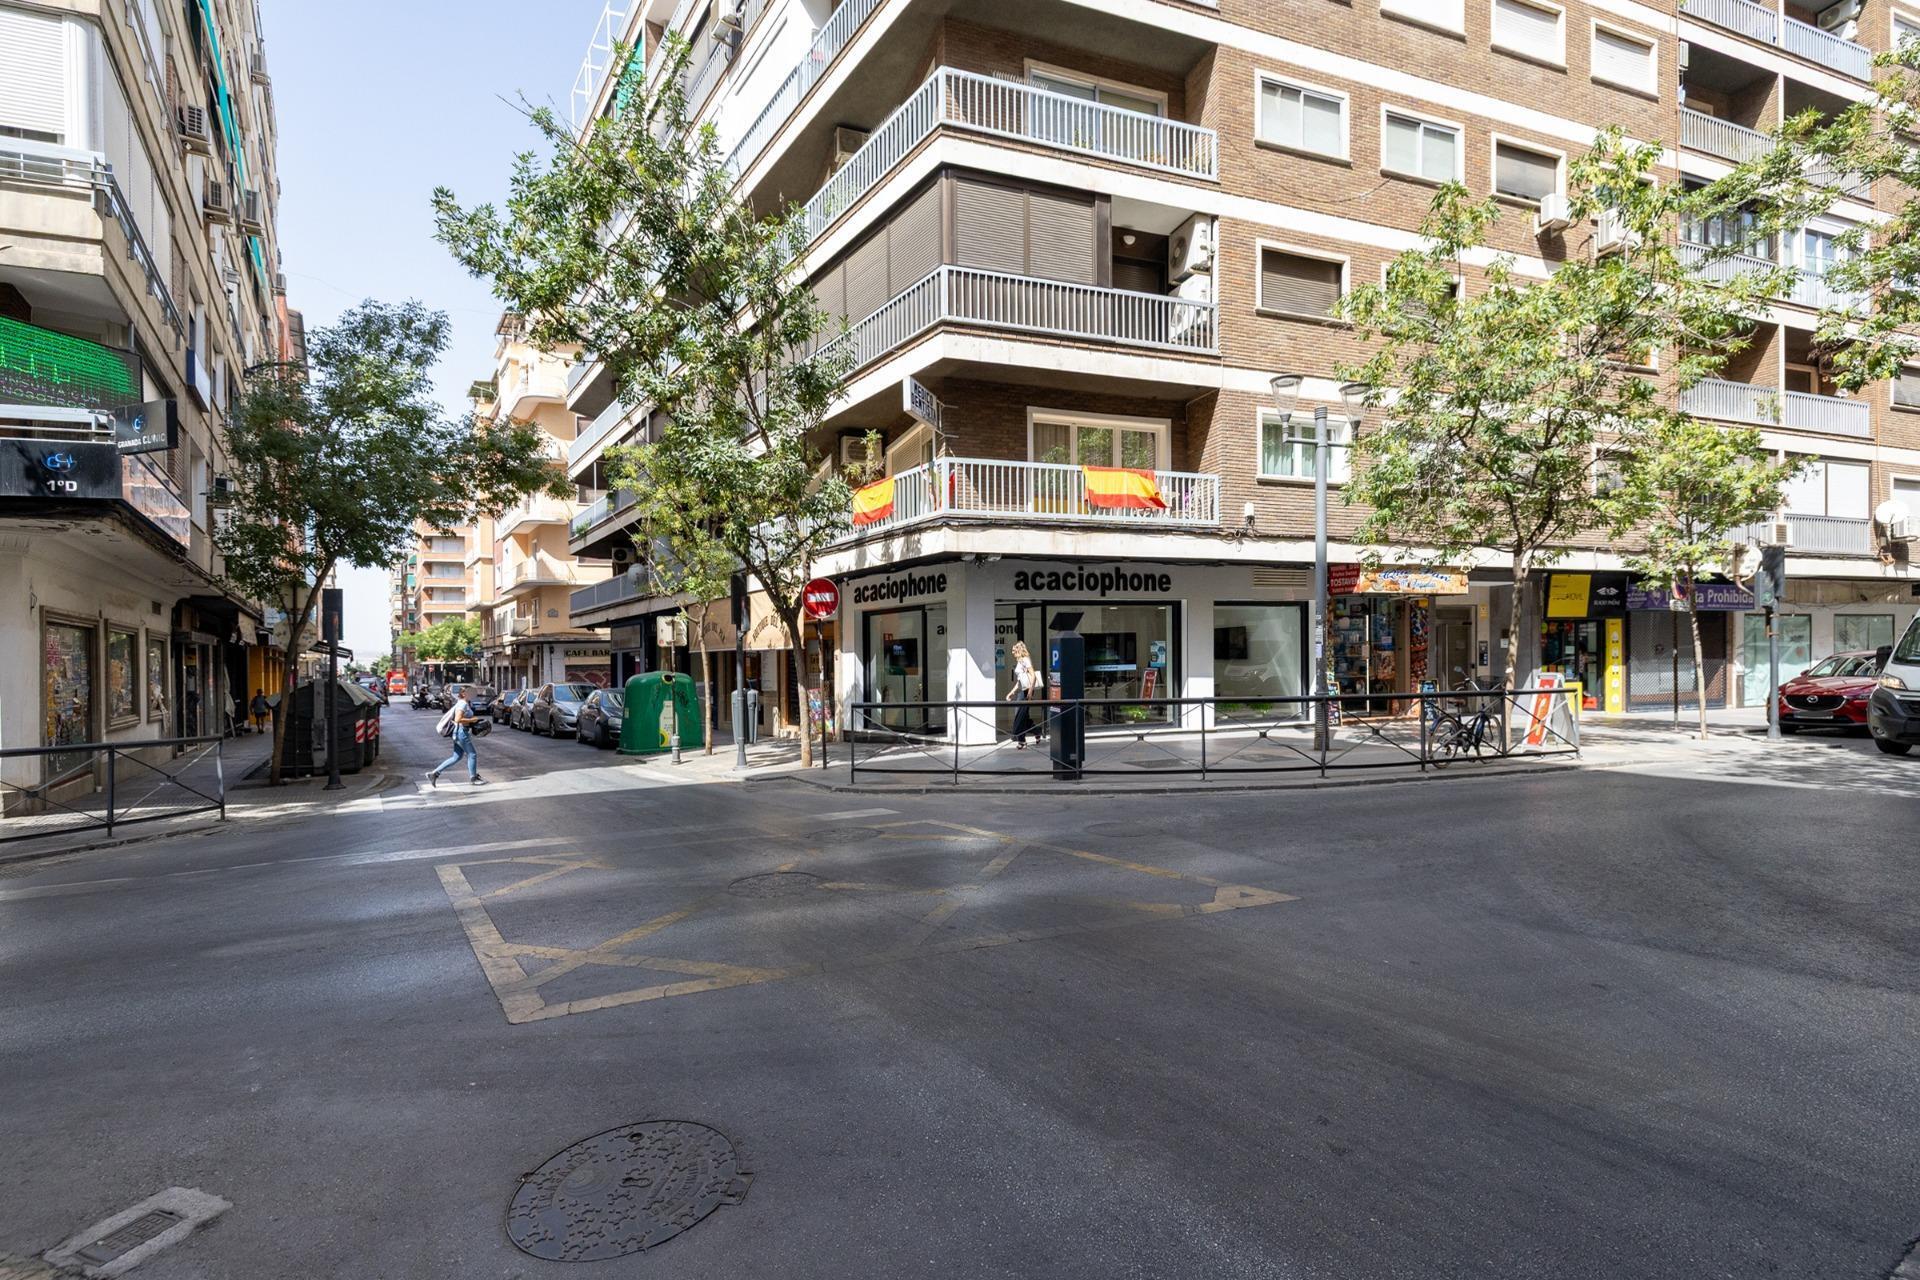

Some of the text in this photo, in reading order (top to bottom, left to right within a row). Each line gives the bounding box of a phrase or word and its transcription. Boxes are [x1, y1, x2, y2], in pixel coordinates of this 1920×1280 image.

[117, 432, 166, 449] GRANADA CLINIC
[853, 572, 947, 604] acaciophone
[1014, 566, 1172, 597] acaciophone
[591, 649, 611, 657] BAR
[1051, 650, 1060, 666] P
